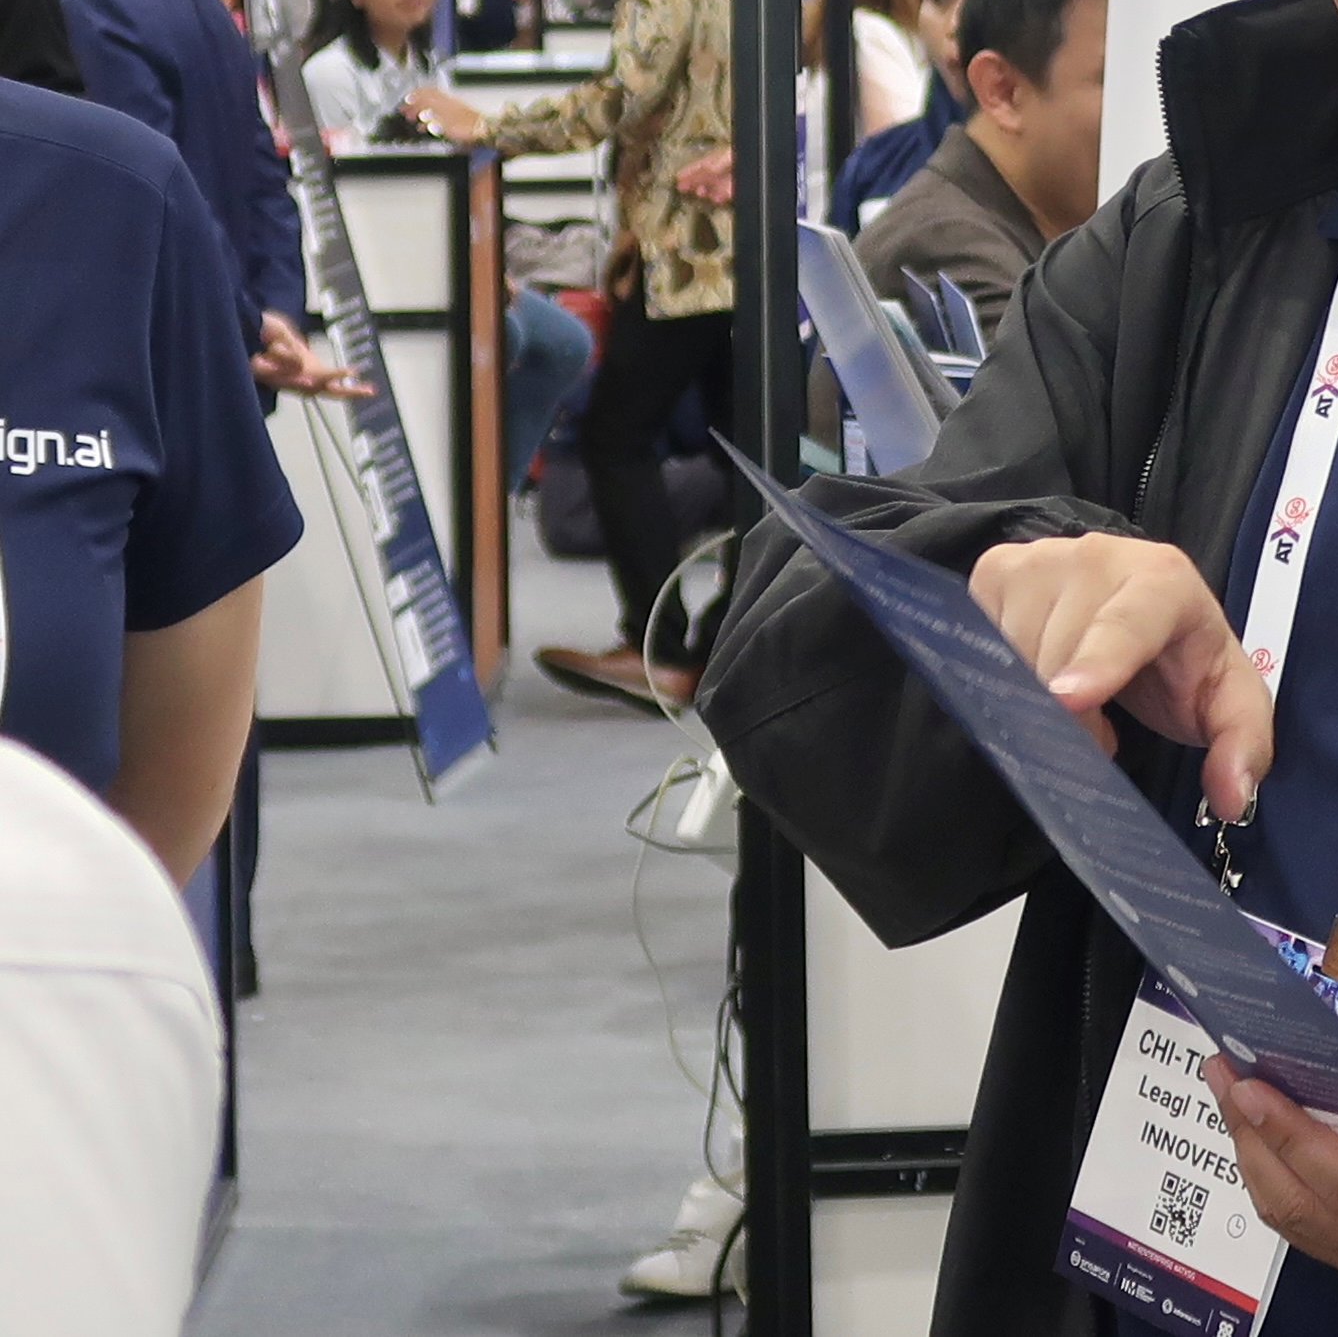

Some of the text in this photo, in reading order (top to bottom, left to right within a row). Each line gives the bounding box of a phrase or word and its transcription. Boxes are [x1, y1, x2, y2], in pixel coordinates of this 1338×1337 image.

[1138, 1075, 1232, 1138] Leagl Tec
[1140, 1120, 1247, 1190] INNOVFES
